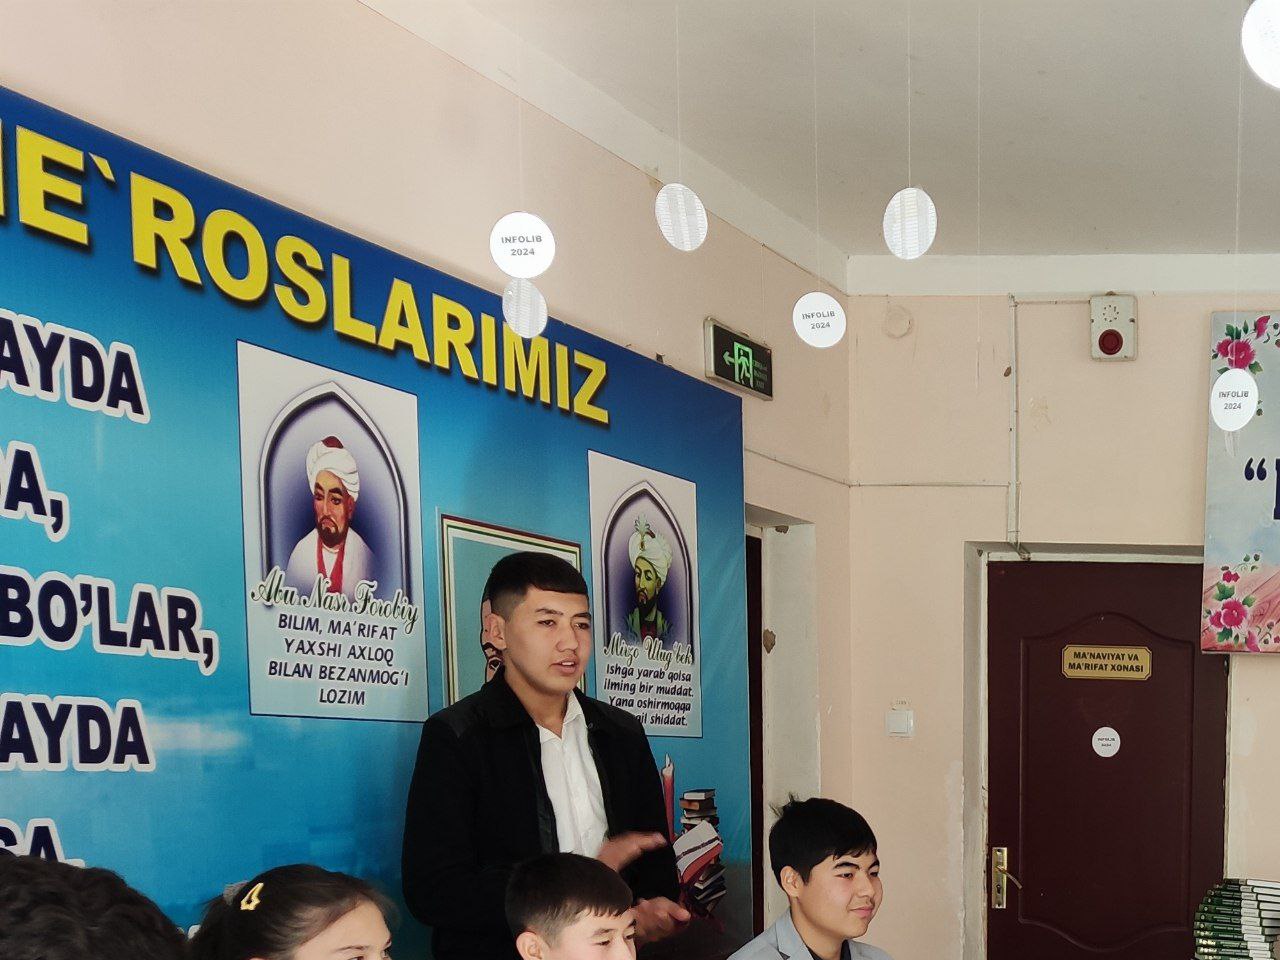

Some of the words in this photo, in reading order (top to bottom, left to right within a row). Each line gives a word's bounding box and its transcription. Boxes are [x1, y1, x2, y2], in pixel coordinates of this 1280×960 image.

[501, 235, 543, 244] INFOLIB
[510, 248, 535, 256] 2024
[801, 310, 836, 320] INFOLIB
[810, 321, 831, 330] 2024
[1218, 390, 1249, 399] INFOLIB
[1223, 402, 1242, 410] 2024
[250, 567, 297, 607] Abu
[302, 574, 349, 612] Nasr
[278, 613, 324, 635] BILIM,
[327, 619, 398, 641] MA'RIFAT
[284, 637, 343, 658] YAXSHI
[346, 644, 395, 667] AXLOQ
[603, 631, 640, 667] Mirzo
[1073, 651, 1126, 661] MA'NAVIYAT
[1127, 653, 1140, 662] VA
[268, 660, 314, 679] BILAN
[318, 665, 410, 686] BEZANMOG'I
[606, 663, 635, 679] Ishga
[636, 667, 666, 680] yarab
[667, 670, 692, 684] qolsa
[1068, 662, 1109, 672] MA'RIFAT
[1110, 664, 1144, 673] XONASI
[603, 677, 637, 695] ilming
[638, 680, 656, 694] bir
[655, 684, 694, 698] muddat.
[319, 688, 366, 706] LOZIM
[608, 695, 635, 708] Yana
[636, 697, 692, 715] oshirmoqqa
[650, 712, 688, 727] shiddat.
[0, 700, 151, 765] AYDA
